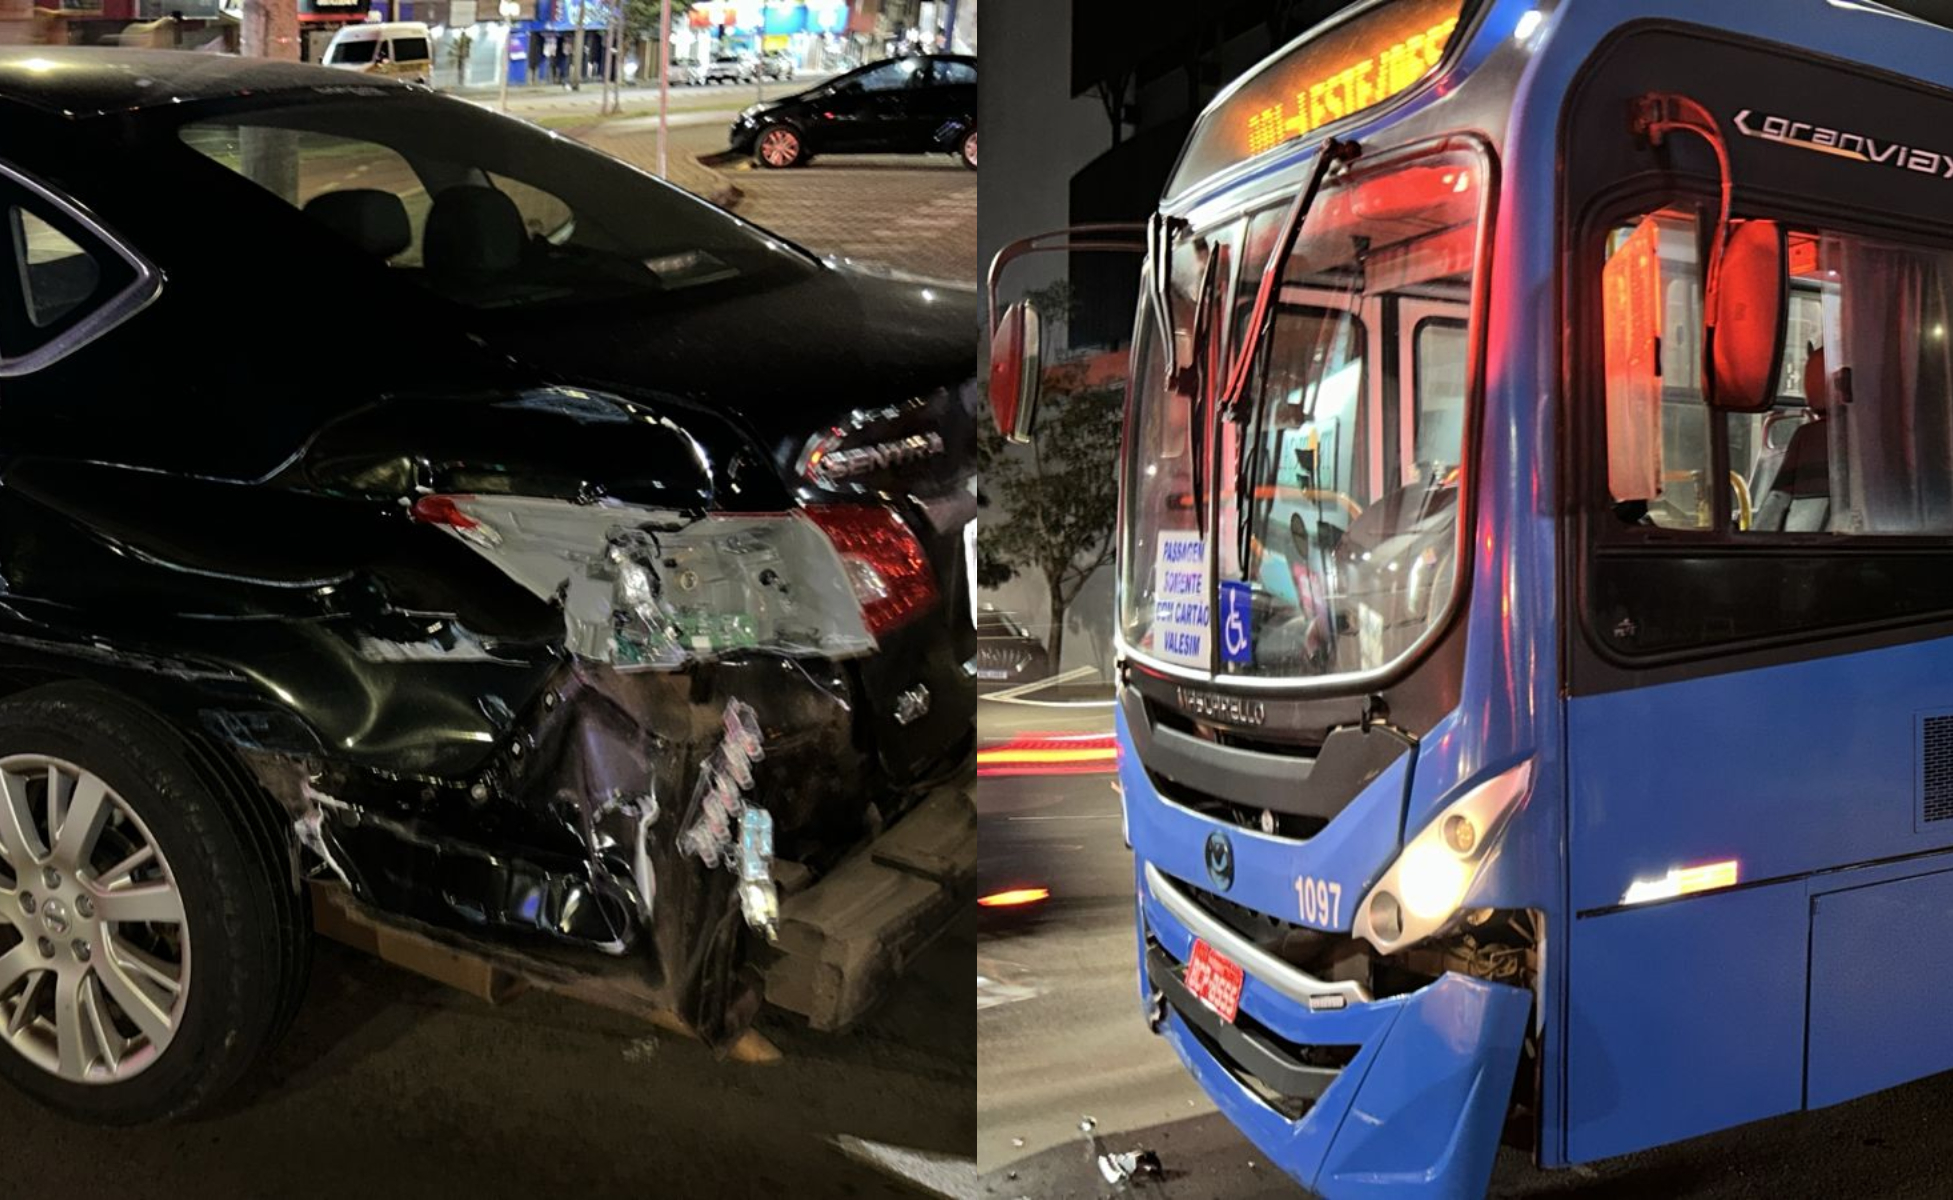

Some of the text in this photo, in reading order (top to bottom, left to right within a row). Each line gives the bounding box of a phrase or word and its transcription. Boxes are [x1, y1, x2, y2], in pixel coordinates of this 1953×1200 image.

[1163, 538, 1205, 563] PASSAGEM
[1162, 571, 1204, 595] SOMENTE
[1156, 600, 1175, 623] COM
[1163, 631, 1201, 656] VALESIM
[1294, 874, 1343, 929] 1097
